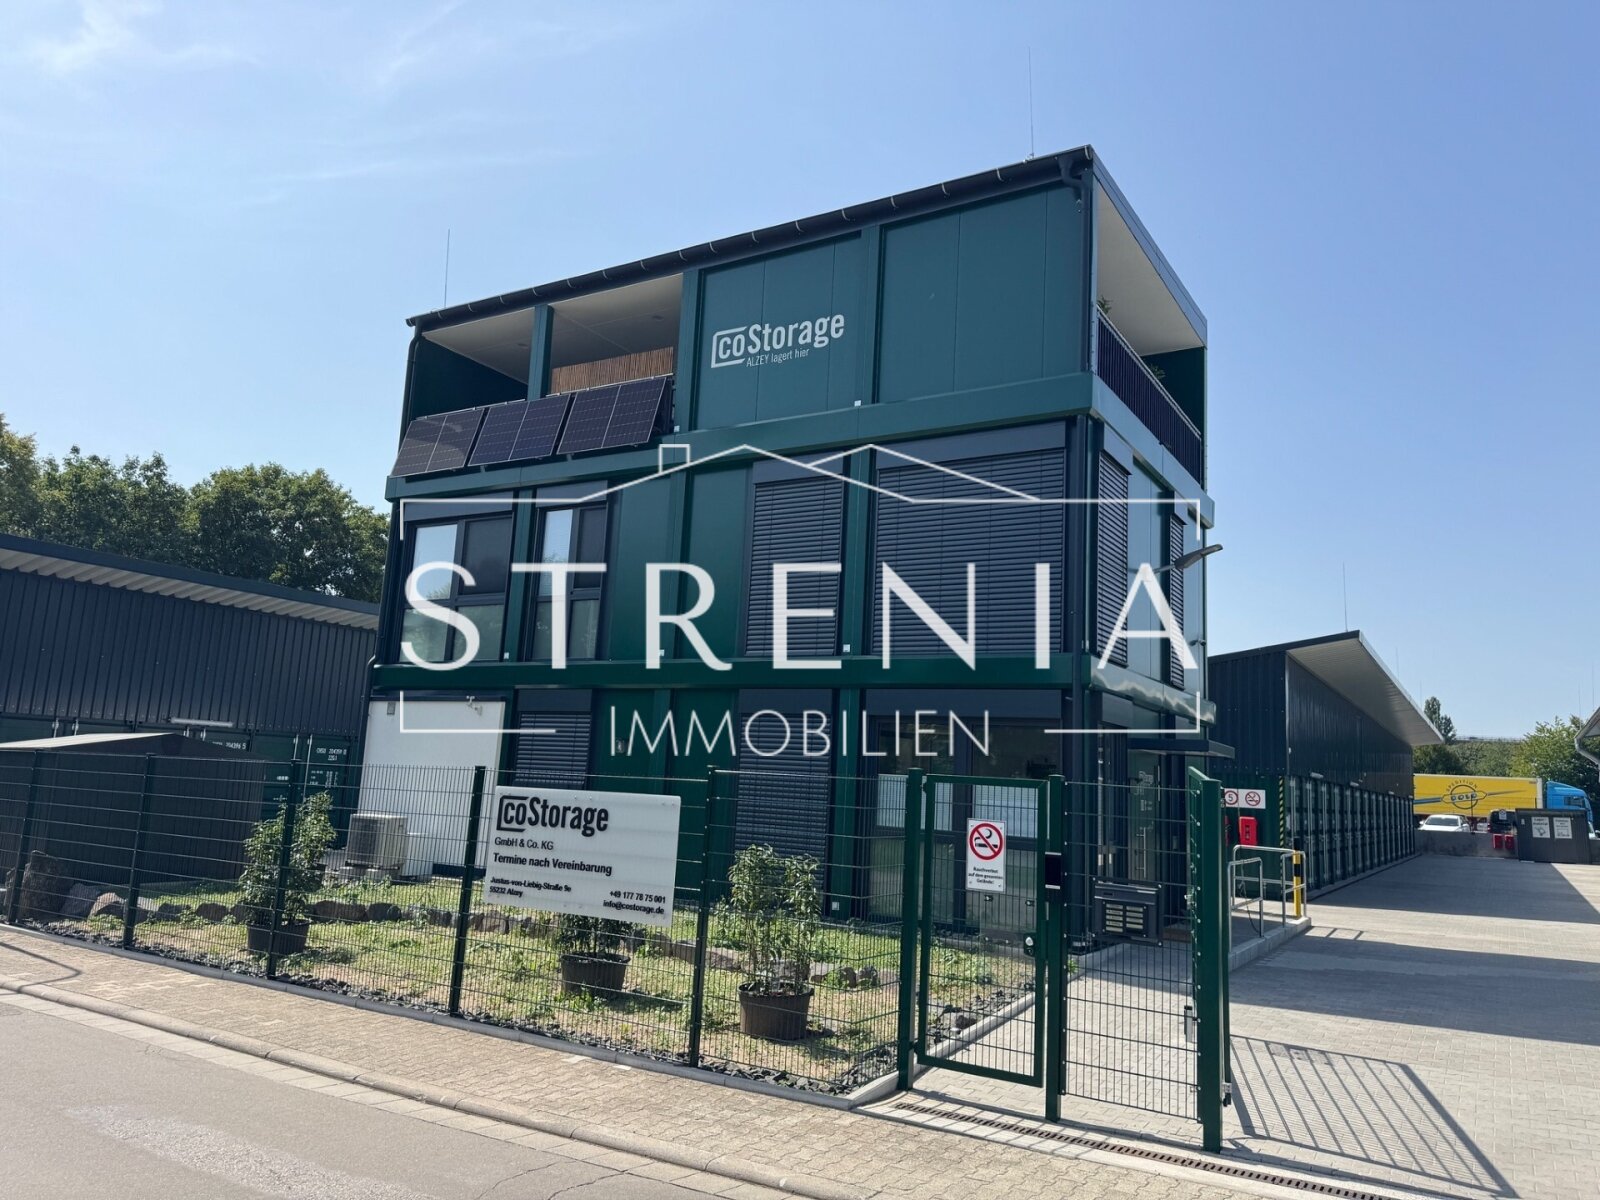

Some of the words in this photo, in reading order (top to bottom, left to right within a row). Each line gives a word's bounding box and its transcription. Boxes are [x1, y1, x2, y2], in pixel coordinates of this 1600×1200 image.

[717, 314, 845, 360] coStorage
[746, 354, 769, 368] ALZEY
[771, 350, 793, 363] lagert
[795, 347, 810, 359] hier
[1228, 793, 1234, 802] 5
[503, 797, 609, 837] coStorage
[494, 836, 518, 847] GmbH
[519, 838, 525, 848] &
[526, 839, 540, 849] Co.
[541, 840, 554, 851] KG
[493, 852, 527, 866] Termine
[528, 857, 550, 868] nach
[552, 859, 612, 877] Vereinbarung
[609, 890, 621, 898] +49
[623, 891, 634, 900] 177
[635, 892, 644, 901] 78
[644, 894, 653, 903] 75
[654, 895, 666, 904] 001
[602, 899, 665, 915] info@costorage.de
